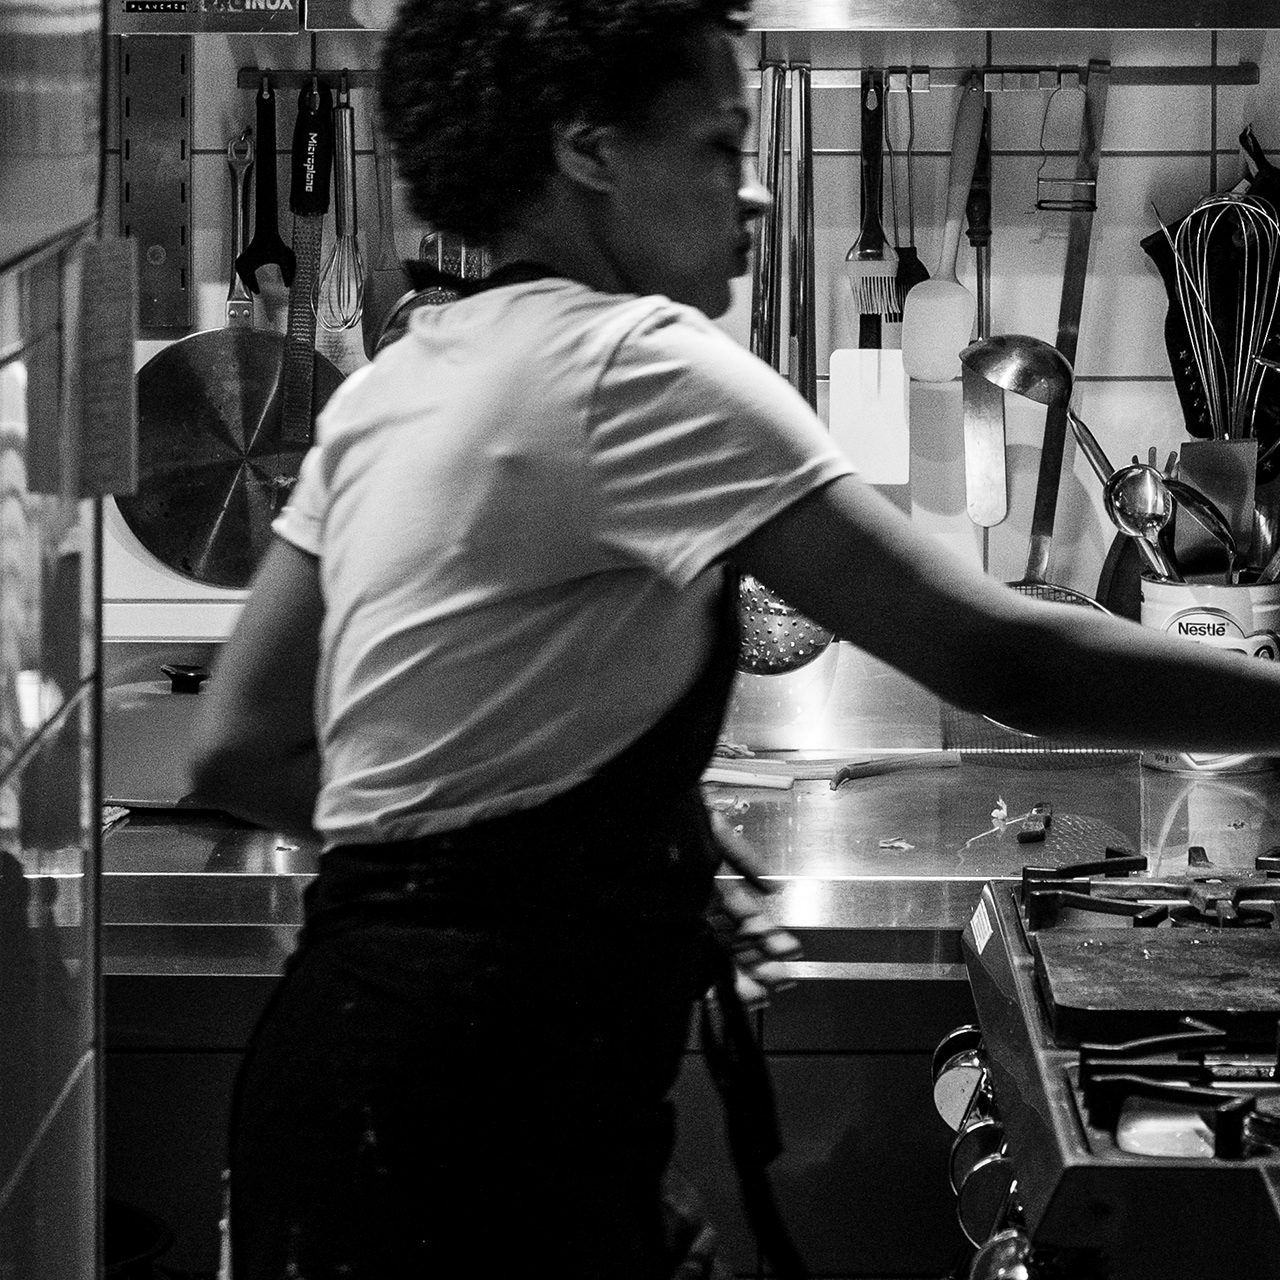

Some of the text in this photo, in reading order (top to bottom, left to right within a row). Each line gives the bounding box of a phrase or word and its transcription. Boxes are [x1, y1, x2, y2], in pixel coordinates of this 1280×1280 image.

[129, 2, 187, 12] PLANCHES
[303, 132, 319, 193] Microplane
[1177, 621, 1226, 637] Nestlé
